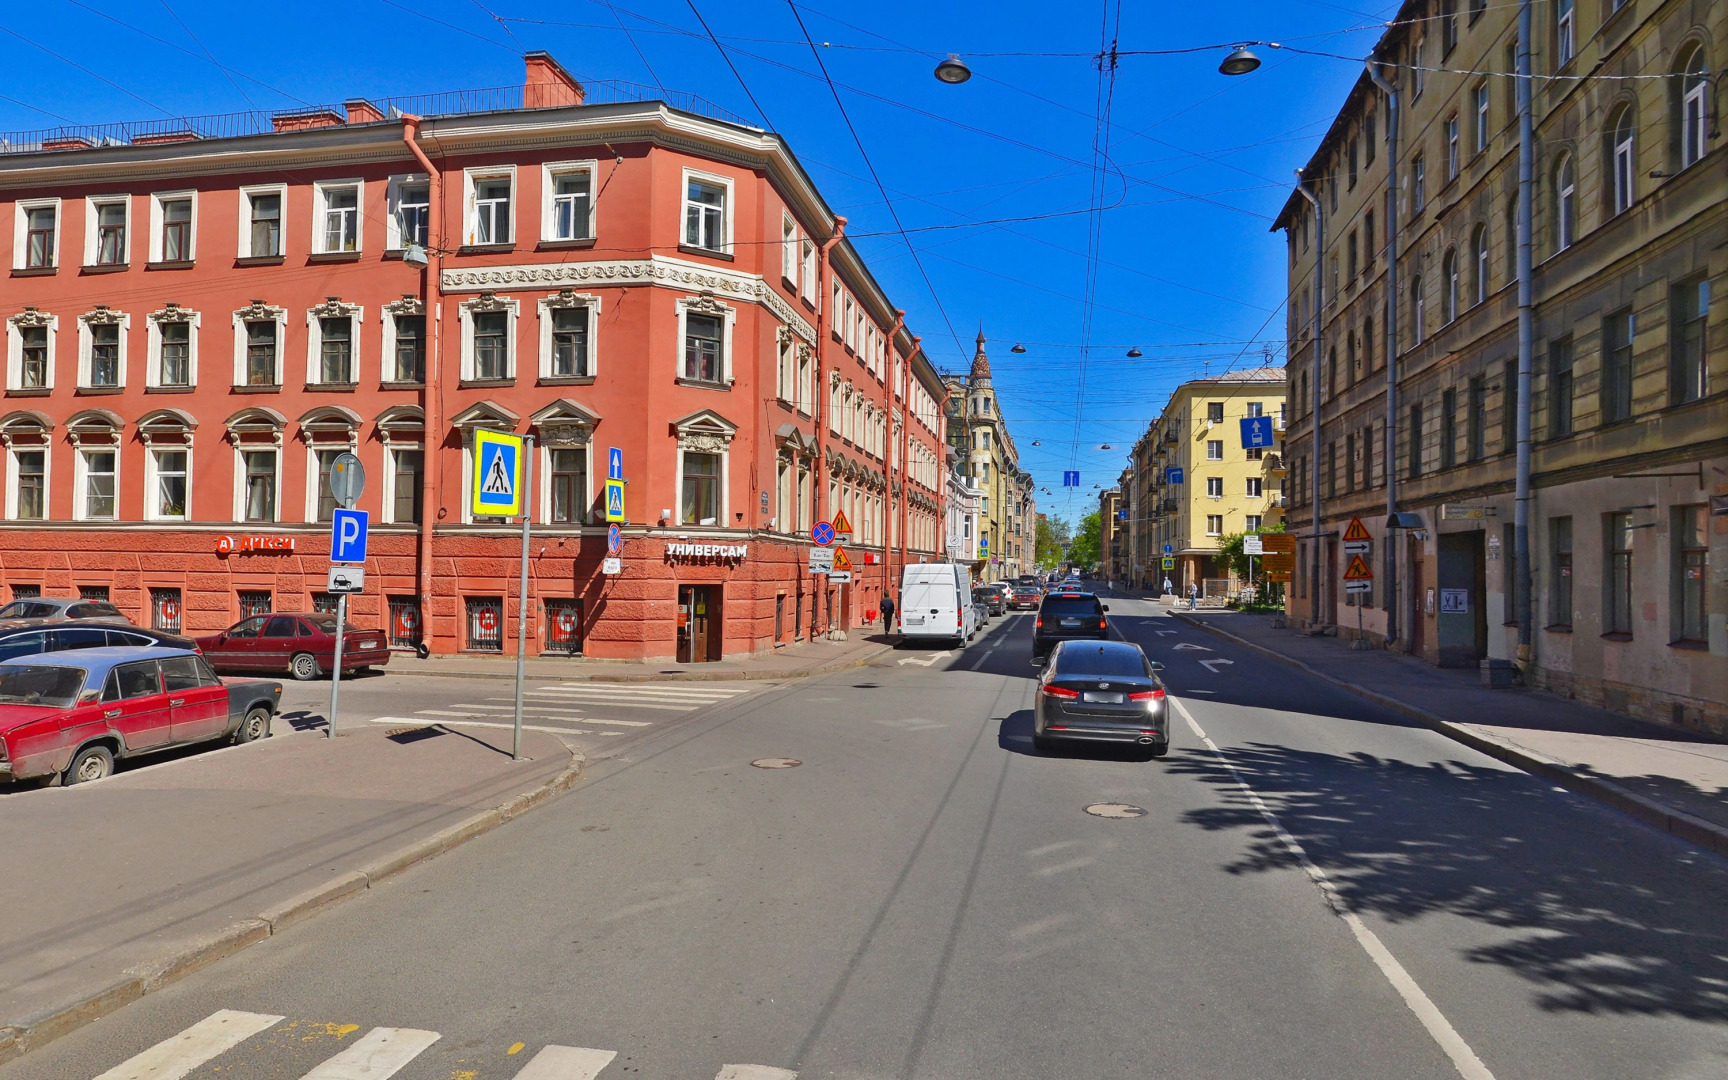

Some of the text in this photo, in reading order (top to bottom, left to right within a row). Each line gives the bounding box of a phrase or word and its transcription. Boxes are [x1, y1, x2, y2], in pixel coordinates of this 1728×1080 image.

[339, 516, 360, 557] P
[240, 537, 295, 551] ДИКСИ
[667, 543, 748, 557] УНИВЕРСАМ
